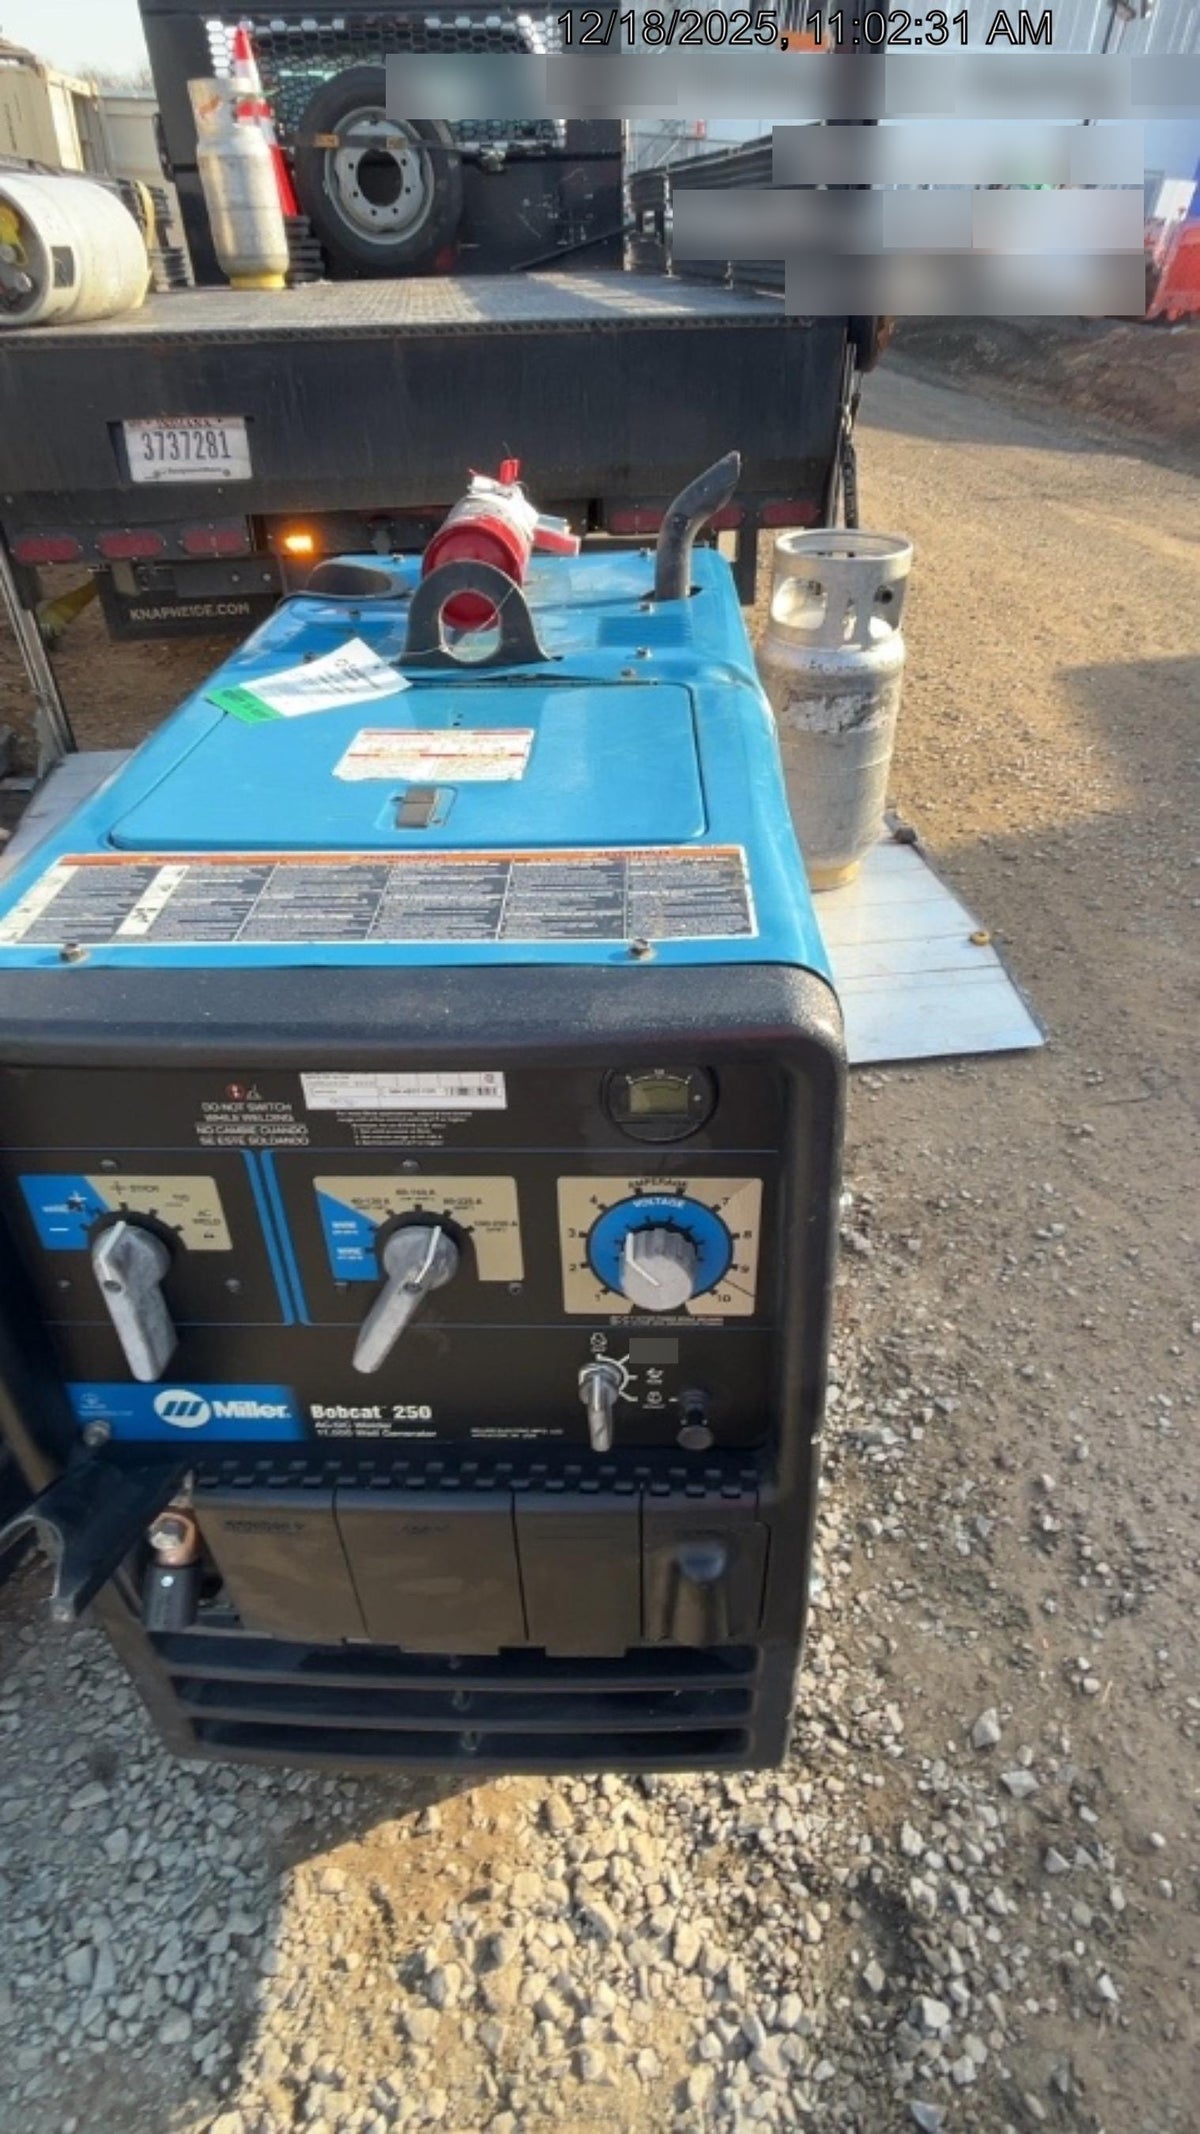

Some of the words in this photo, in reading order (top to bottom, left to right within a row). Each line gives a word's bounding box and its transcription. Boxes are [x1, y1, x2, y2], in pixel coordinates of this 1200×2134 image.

[141, 430, 232, 461] 3737281
[632, 1197, 685, 1208] VOLTAGE
[717, 1294, 732, 1303] 10
[212, 1400, 286, 1419] Miller
[310, 1403, 383, 1420] Bobcat
[392, 1405, 433, 1419] 250
